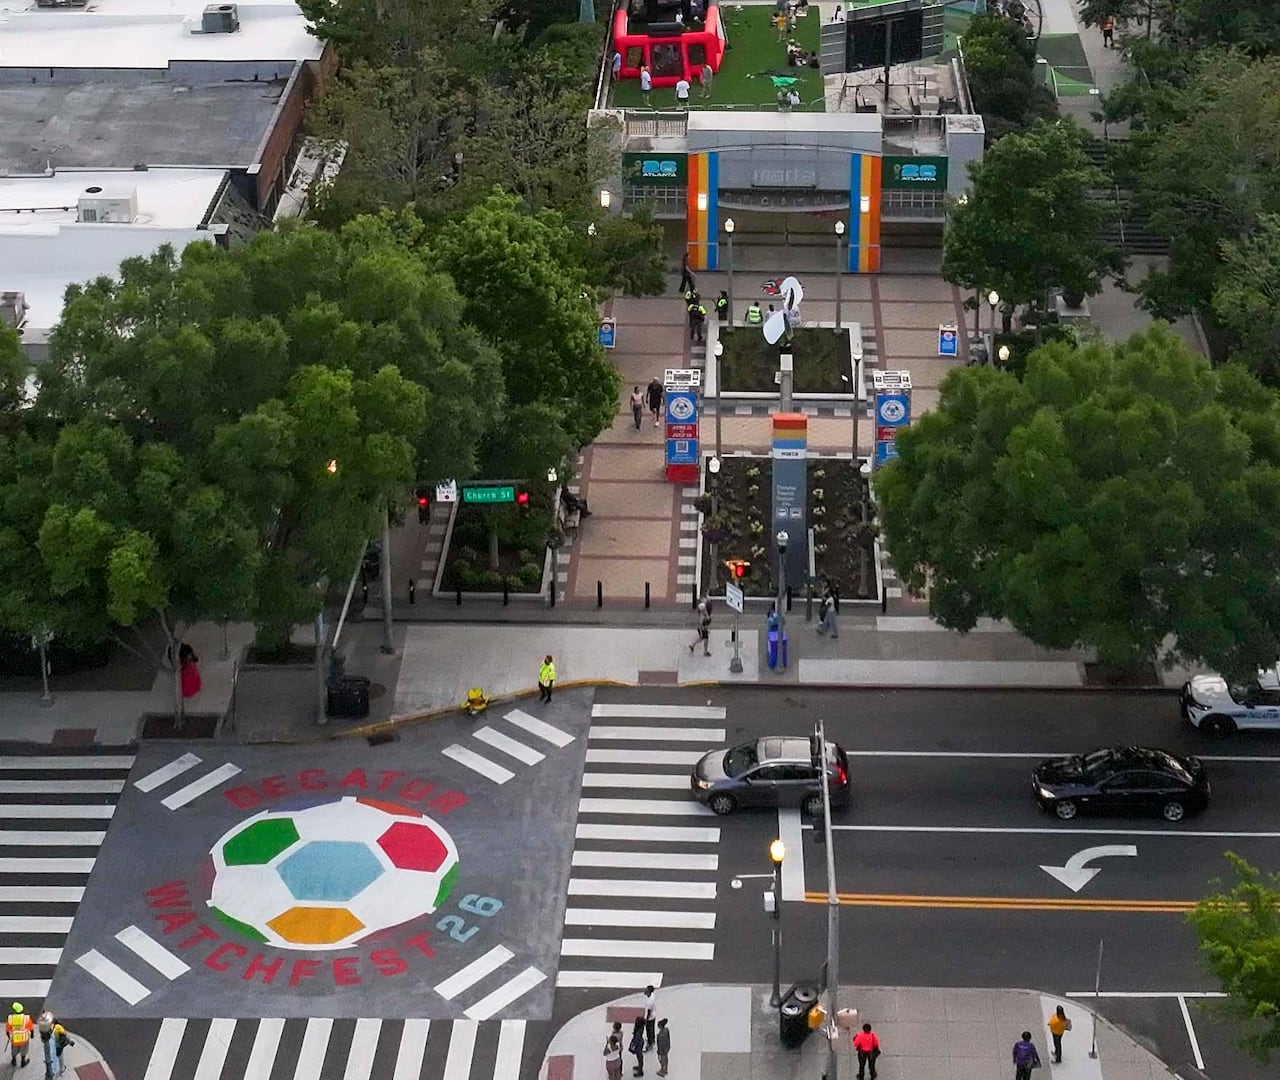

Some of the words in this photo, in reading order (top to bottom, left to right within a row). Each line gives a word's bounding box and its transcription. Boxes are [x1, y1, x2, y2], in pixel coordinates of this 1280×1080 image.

[753, 168, 815, 183] marta
[467, 491, 496, 499] Church
[501, 491, 510, 499] St
[224, 768, 470, 816] DECATUR
[145, 879, 439, 987] WATCHFEST
[435, 893, 504, 944] 26
